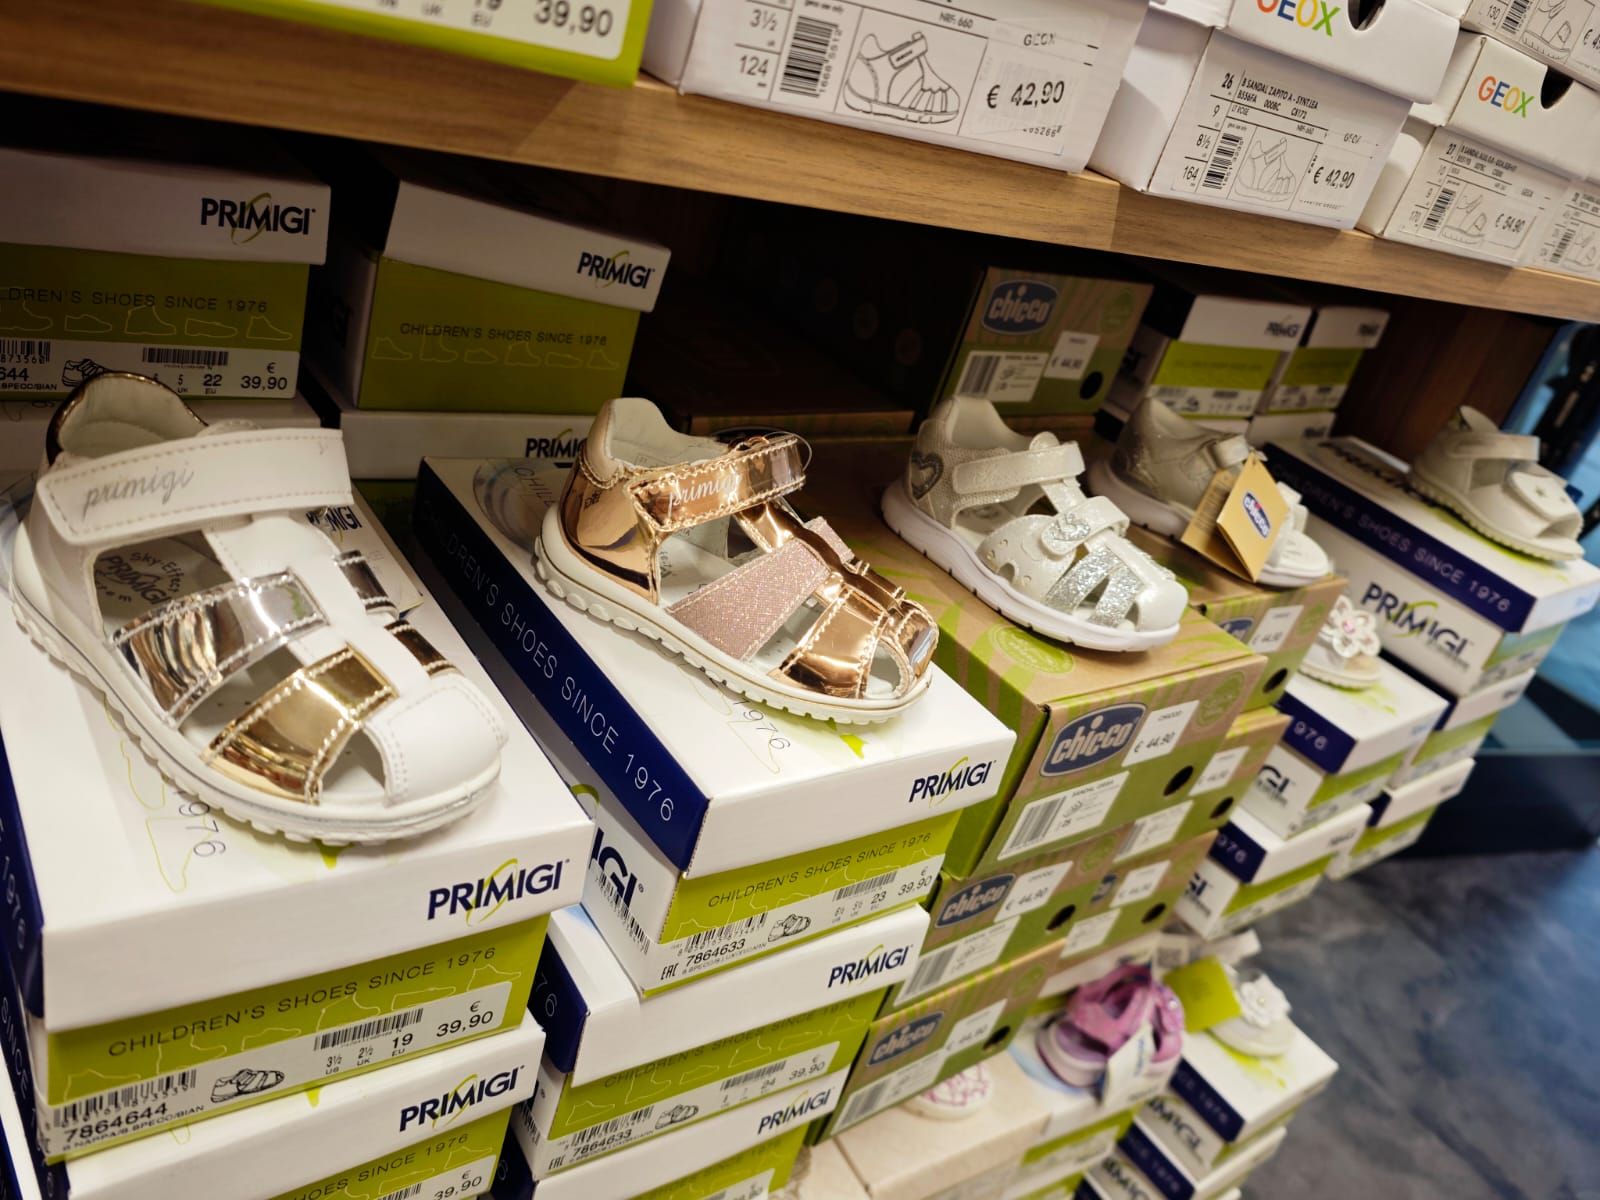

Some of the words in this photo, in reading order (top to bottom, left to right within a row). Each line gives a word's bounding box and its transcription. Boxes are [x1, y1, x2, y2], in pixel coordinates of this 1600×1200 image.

[535, 0, 613, 37] 39,90
[739, 55, 768, 77] 124
[987, 84, 1001, 109] €
[1011, 80, 1065, 108] 42,90
[1221, 73, 1235, 90] 26
[1211, 104, 1221, 118] 9
[1478, 76, 1534, 118] GEOX
[1182, 165, 1199, 181] 164
[1313, 166, 1324, 185] €
[1325, 168, 1355, 189] 42,90
[200, 196, 311, 238] PRIMIGI
[577, 251, 653, 289] PRIMIGI
[92, 291, 155, 308] SHOES
[165, 295, 217, 310] SINCE
[226, 299, 268, 313] 1976
[400, 322, 482, 339] CHILDREN'S
[487, 328, 532, 342] SHOES
[536, 331, 574, 346] SINCE
[0, 366, 29, 381] 644
[203, 374, 223, 387] 22
[266, 361, 276, 374] €
[240, 375, 288, 390] 39,90
[525, 437, 587, 458] PRIMI
[81, 460, 194, 521] primigi
[1358, 513, 1412, 553] SHOES
[1414, 547, 1465, 585] SINCE
[1468, 579, 1512, 613] 1976
[1361, 582, 1470, 657] PRIMIGI
[500, 602, 558, 679] SHOES
[560, 676, 620, 755] SINCE
[625, 753, 675, 822] 1976
[732, 699, 791, 751] 1976
[1051, 714, 1135, 765] chicco
[1294, 721, 1328, 750] 976
[909, 760, 993, 803] PRIMIGI
[1215, 833, 1248, 865] 976
[707, 871, 800, 908] CHILDREN'S
[803, 855, 851, 879] SHOES
[856, 844, 896, 863] SINCE
[900, 832, 932, 854] 1976
[427, 860, 564, 922] PRIMIGI
[871, 890, 887, 905] 23
[942, 884, 1007, 921] chicco
[686, 938, 746, 967] 7864633
[828, 945, 911, 988] PRIMIGI
[108, 1004, 267, 1058] CHILDREN'S
[277, 981, 359, 1014] SHOES
[367, 961, 437, 991] SINCE
[445, 947, 496, 970] 1976
[470, 1001, 481, 1013] €
[535, 971, 558, 1017] 76
[436, 1010, 494, 1038] 39,90
[391, 1048, 405, 1057] EU
[392, 1033, 413, 1048] 19
[399, 1066, 523, 1132] PRIMIGI
[757, 1087, 832, 1135] PRIMIGI
[64, 1102, 168, 1143] 7864644
[573, 1128, 633, 1157] 7864633
[294, 1177, 349, 1200] HOES
[357, 1153, 416, 1183] SINCE
[425, 1133, 469, 1157] 1976
[461, 1169, 472, 1180] €
[433, 1175, 483, 1200] 39,90
